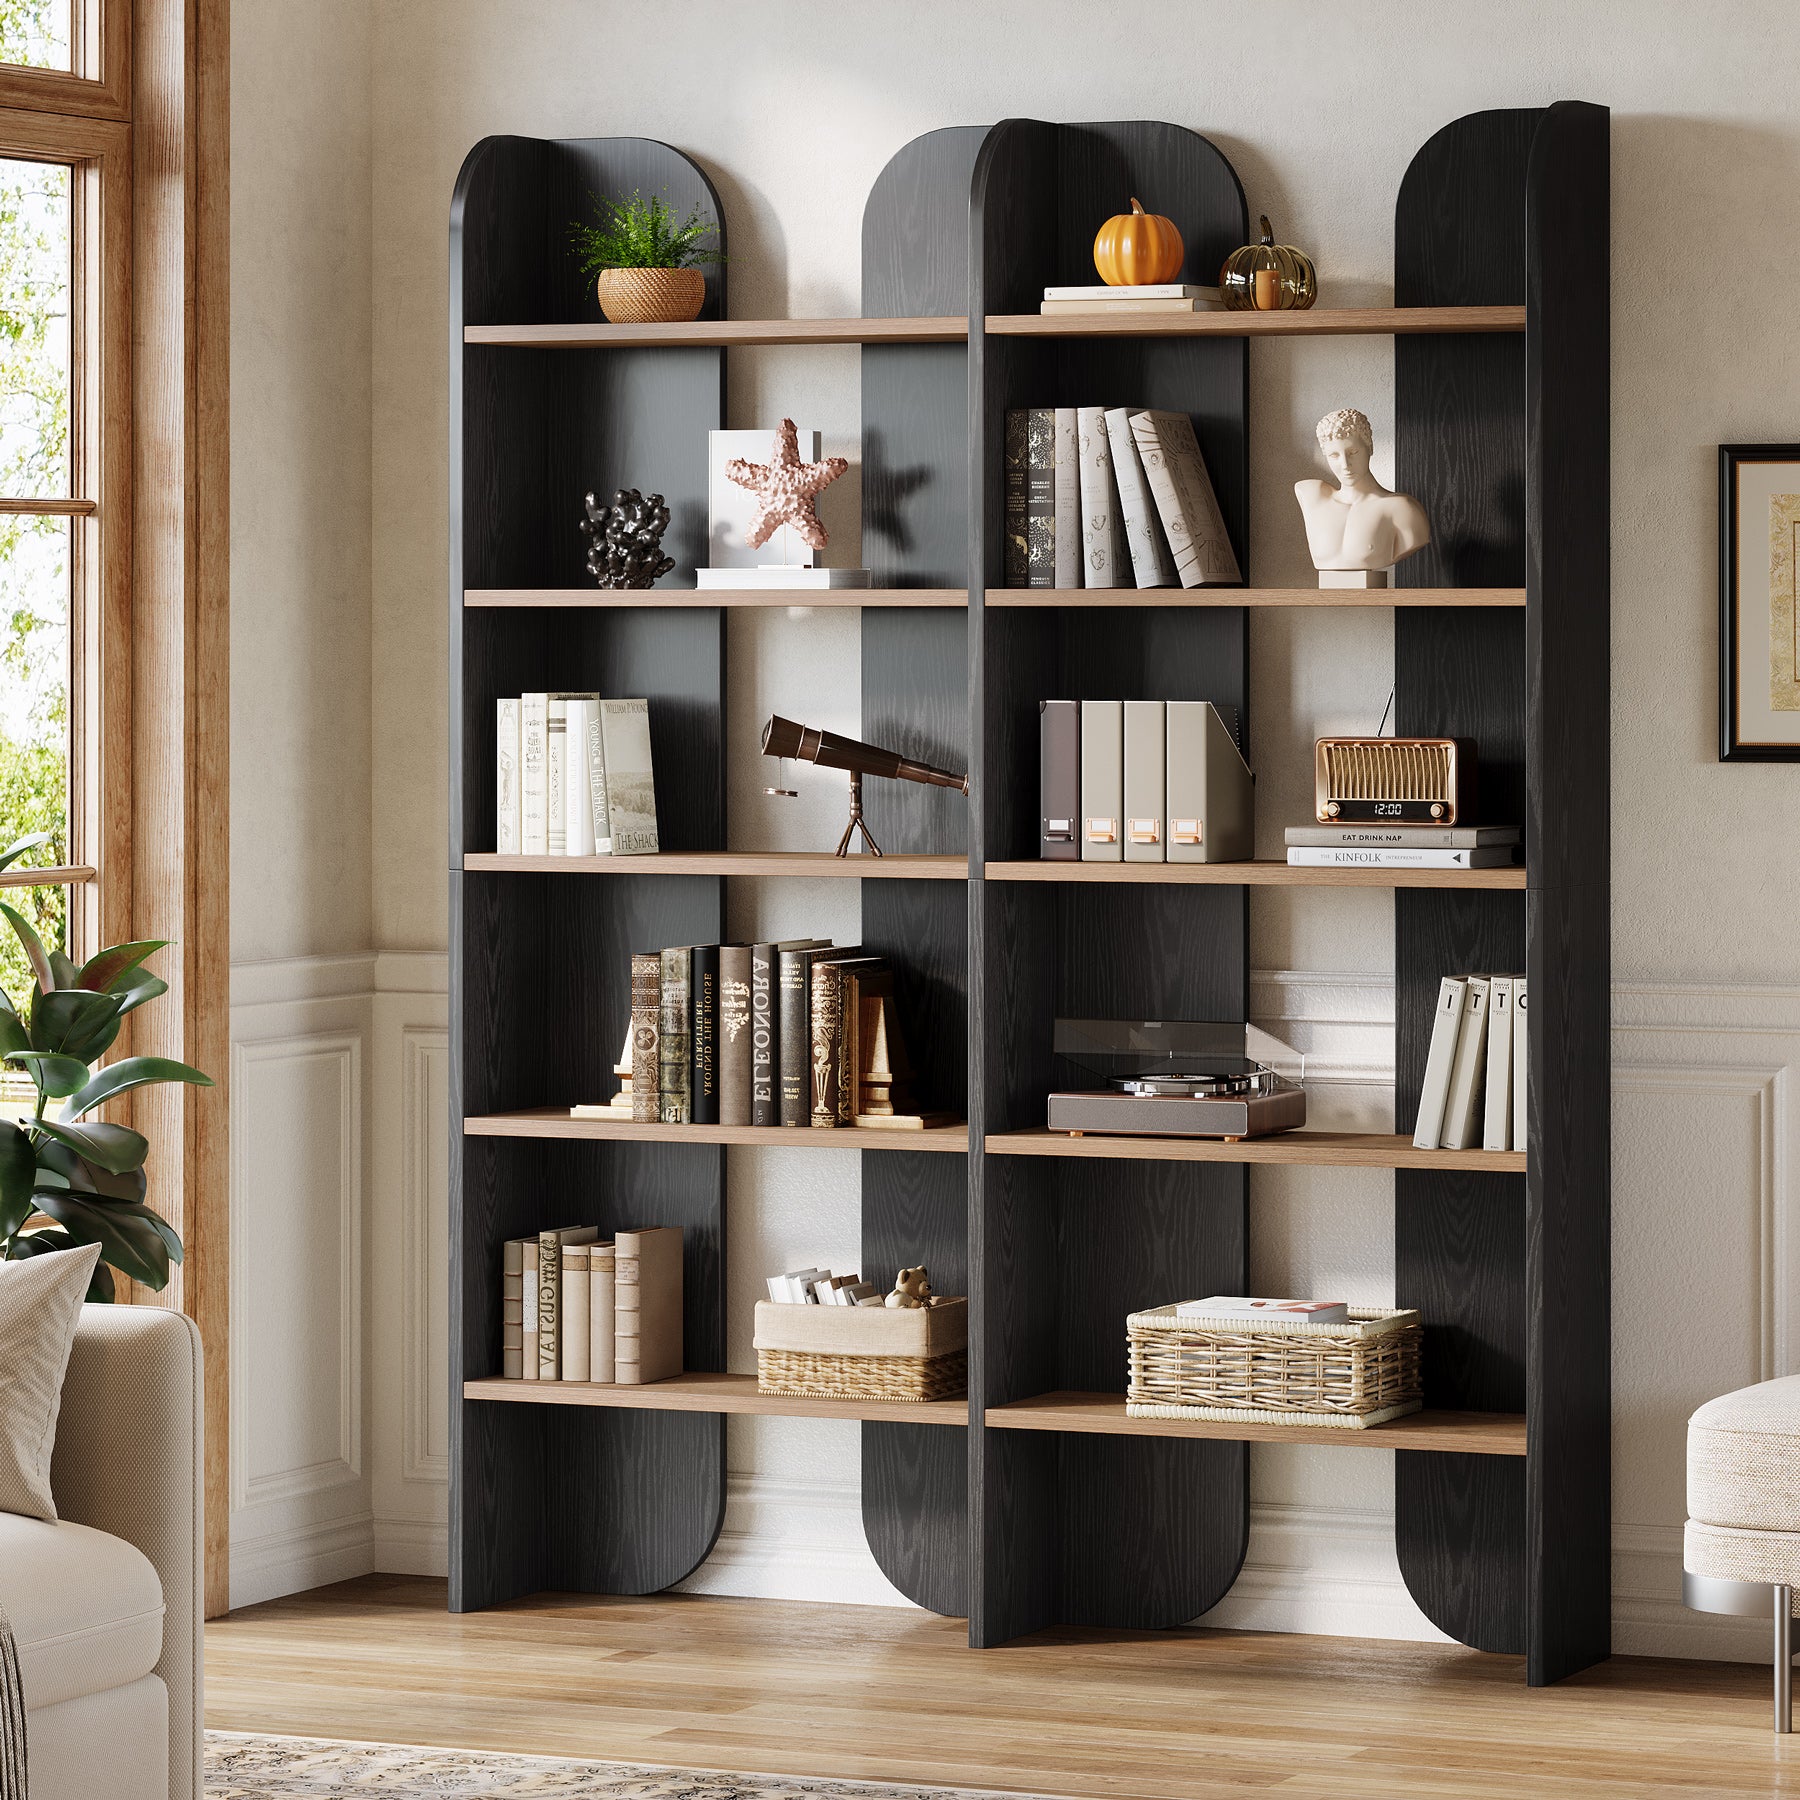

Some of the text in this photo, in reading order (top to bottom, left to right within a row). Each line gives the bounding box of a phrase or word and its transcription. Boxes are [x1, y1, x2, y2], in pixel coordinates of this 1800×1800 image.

[588, 718, 607, 825] YOUNG THE SHACK
[1374, 804, 1402, 816] 12:00
[616, 832, 632, 850] THE
[1334, 852, 1382, 862] KINFOLK
[1472, 993, 1482, 1008] T
[1498, 992, 1506, 1008] T
